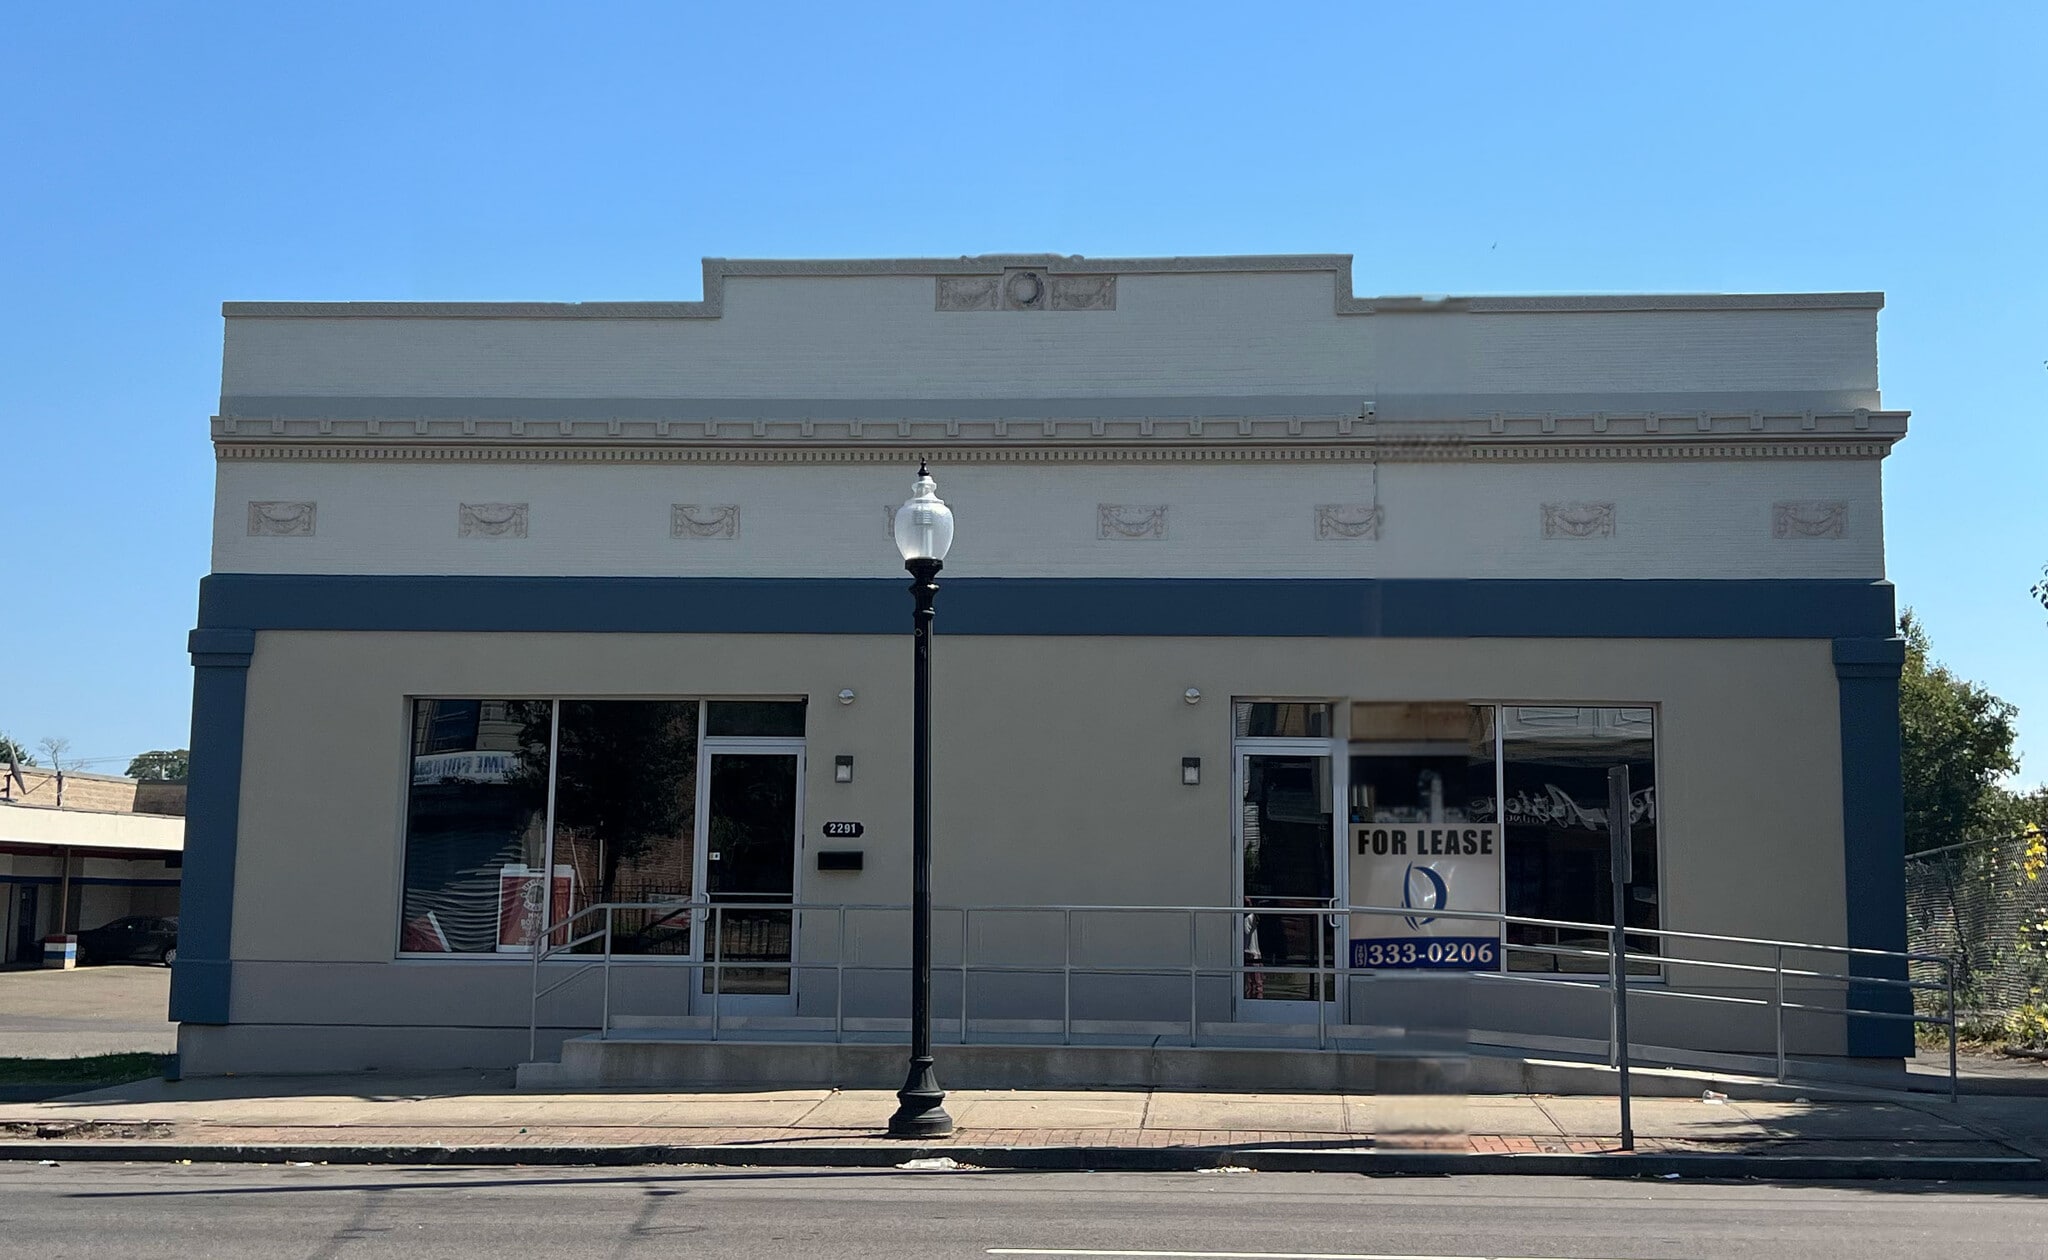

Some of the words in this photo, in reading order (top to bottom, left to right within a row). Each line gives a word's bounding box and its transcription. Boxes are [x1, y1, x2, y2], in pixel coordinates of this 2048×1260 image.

[829, 823, 856, 834] 2291
[1358, 829, 1407, 855] FOR
[1417, 829, 1493, 855] LEASE
[1369, 943, 1493, 965] 333-0206
